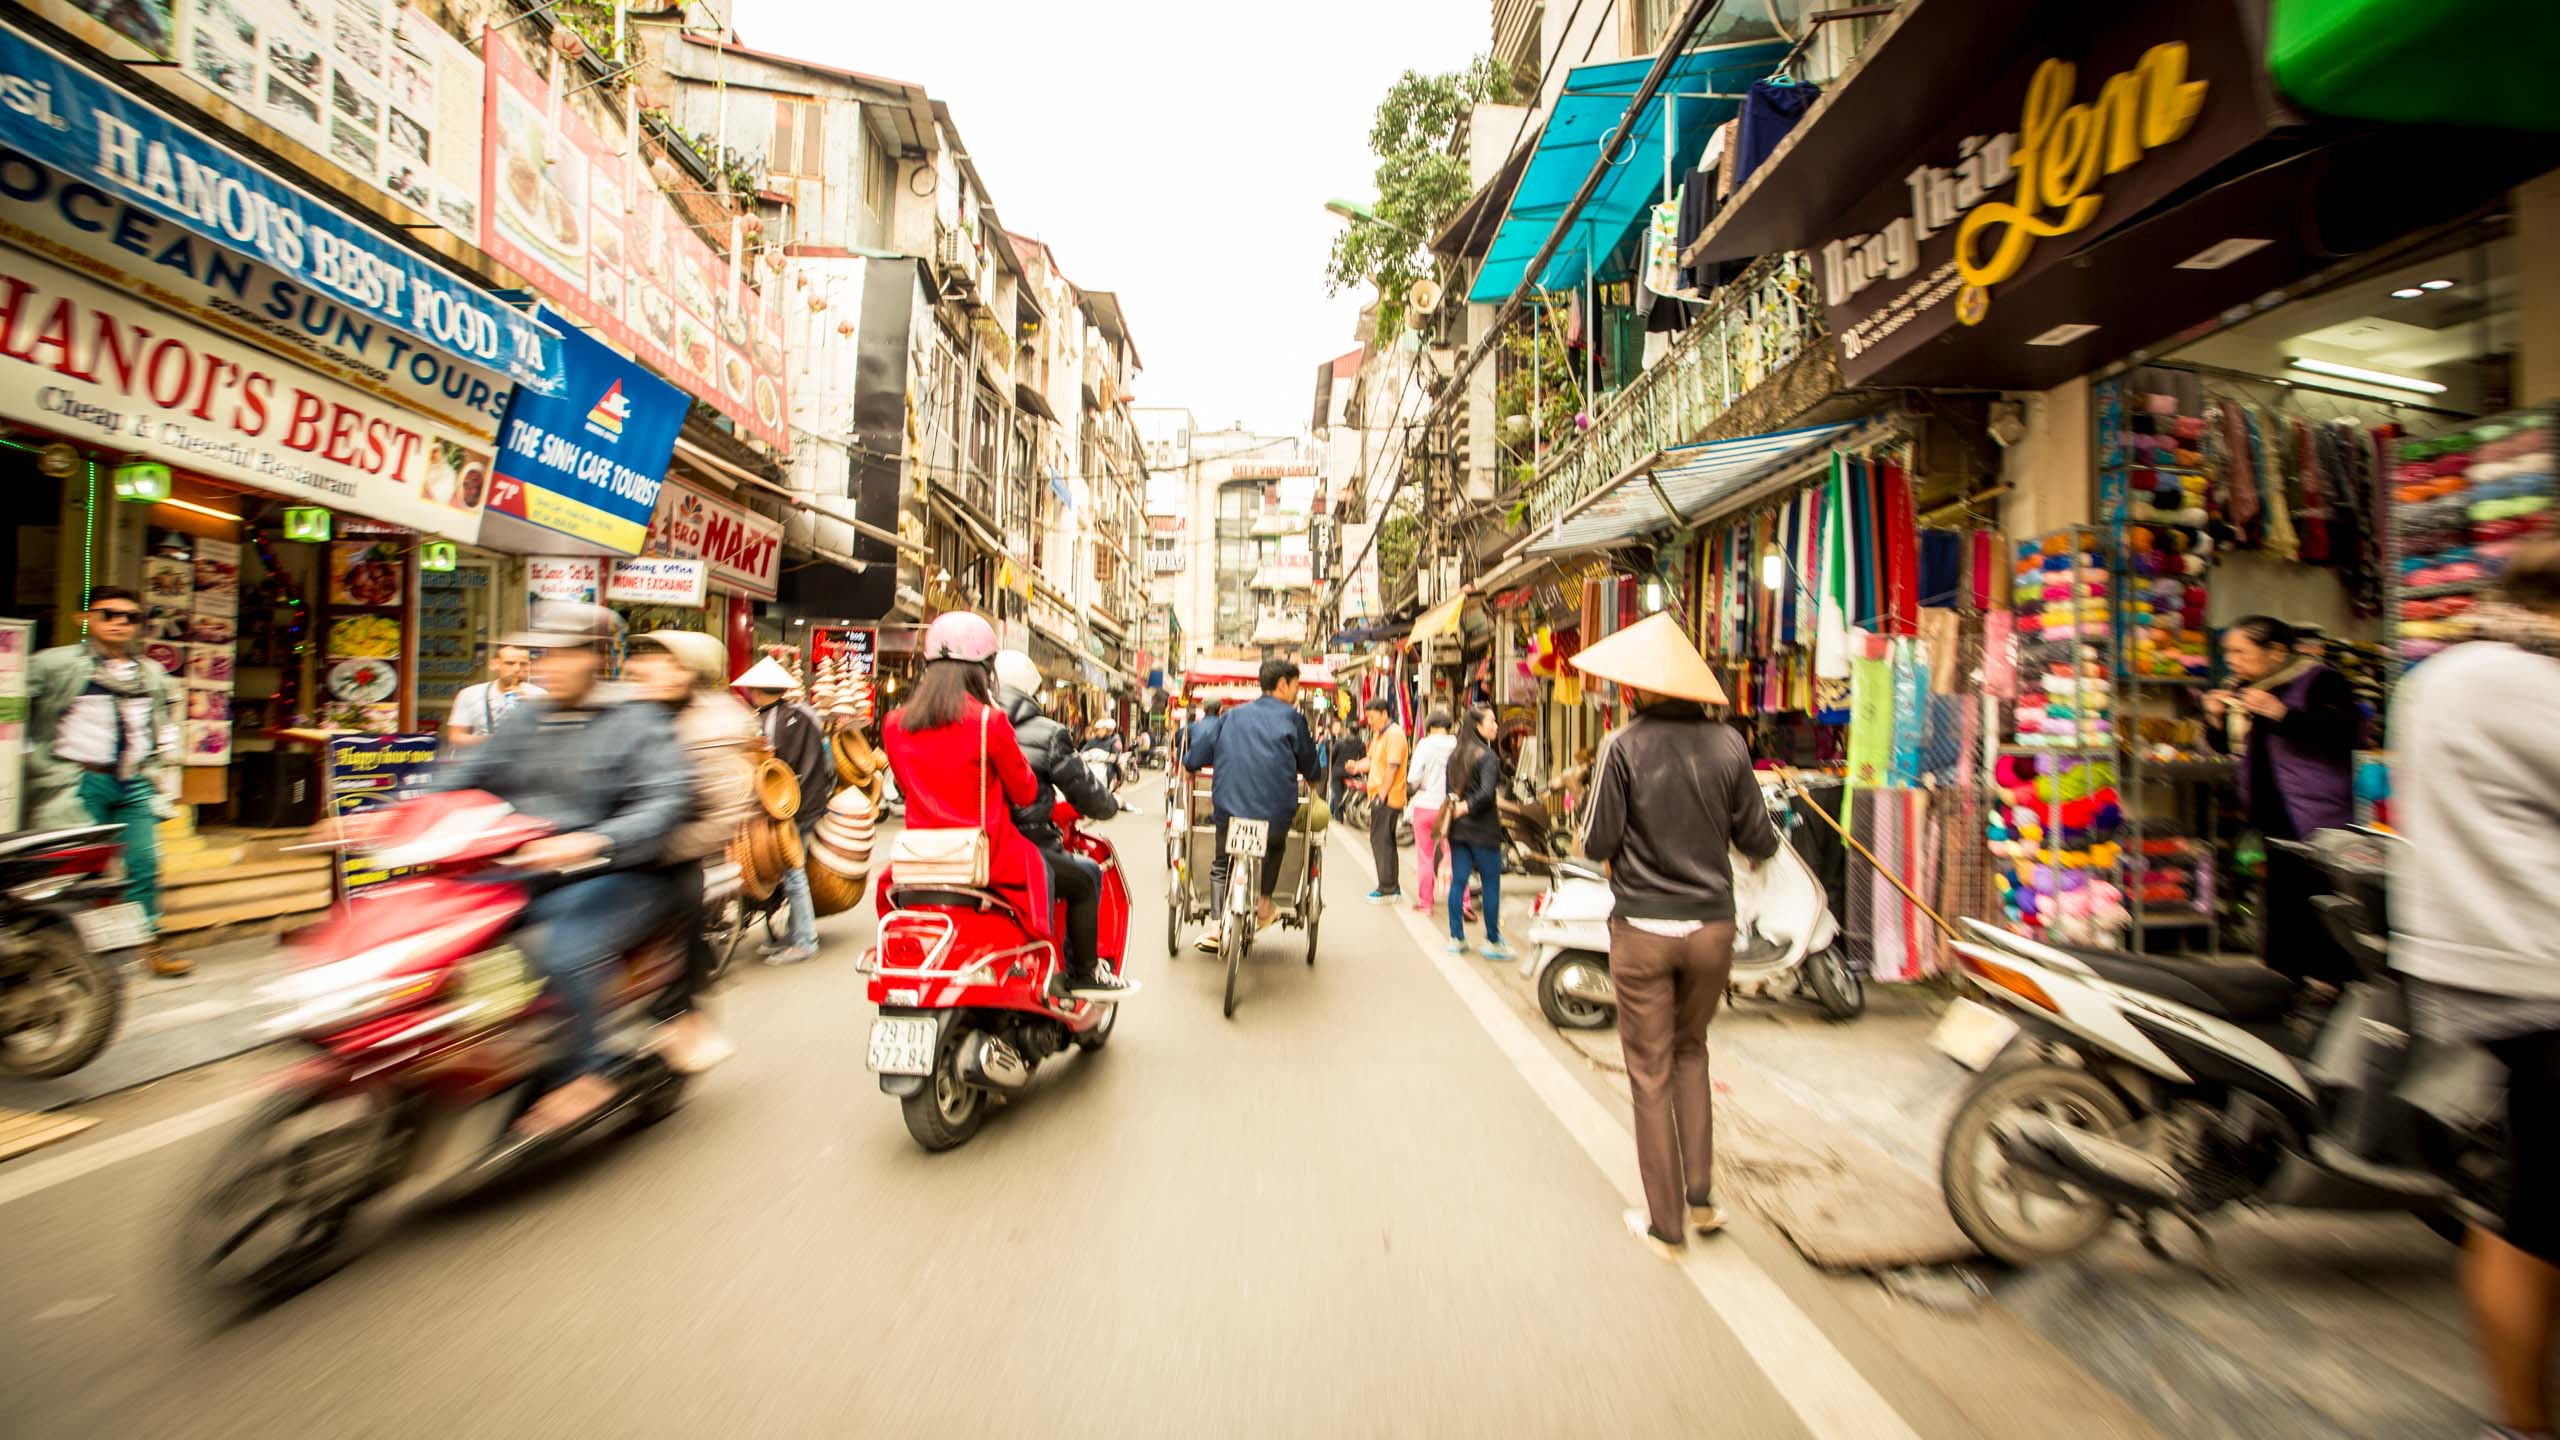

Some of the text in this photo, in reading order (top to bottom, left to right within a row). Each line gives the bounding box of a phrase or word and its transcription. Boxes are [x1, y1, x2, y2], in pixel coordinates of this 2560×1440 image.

[0, 148, 253, 299] OCEAN
[263, 281, 373, 353] SUN
[385, 335, 503, 420] TOURS
[92, 107, 304, 270] HANOI'S
[310, 225, 406, 318] BEST
[411, 276, 499, 360] FOOD
[507, 322, 546, 372] 7A
[38, 384, 122, 434] Cheap
[159, 421, 251, 468] Cheerful
[253, 451, 358, 498] Restaurant
[282, 388, 423, 484] BEST
[507, 418, 544, 459] THE
[537, 433, 582, 475] SINH
[577, 450, 614, 489] CAFE
[609, 464, 662, 508] TOURIST
[613, 575, 694, 593] MONEY EXCHANGE
[701, 510, 778, 578] MART
